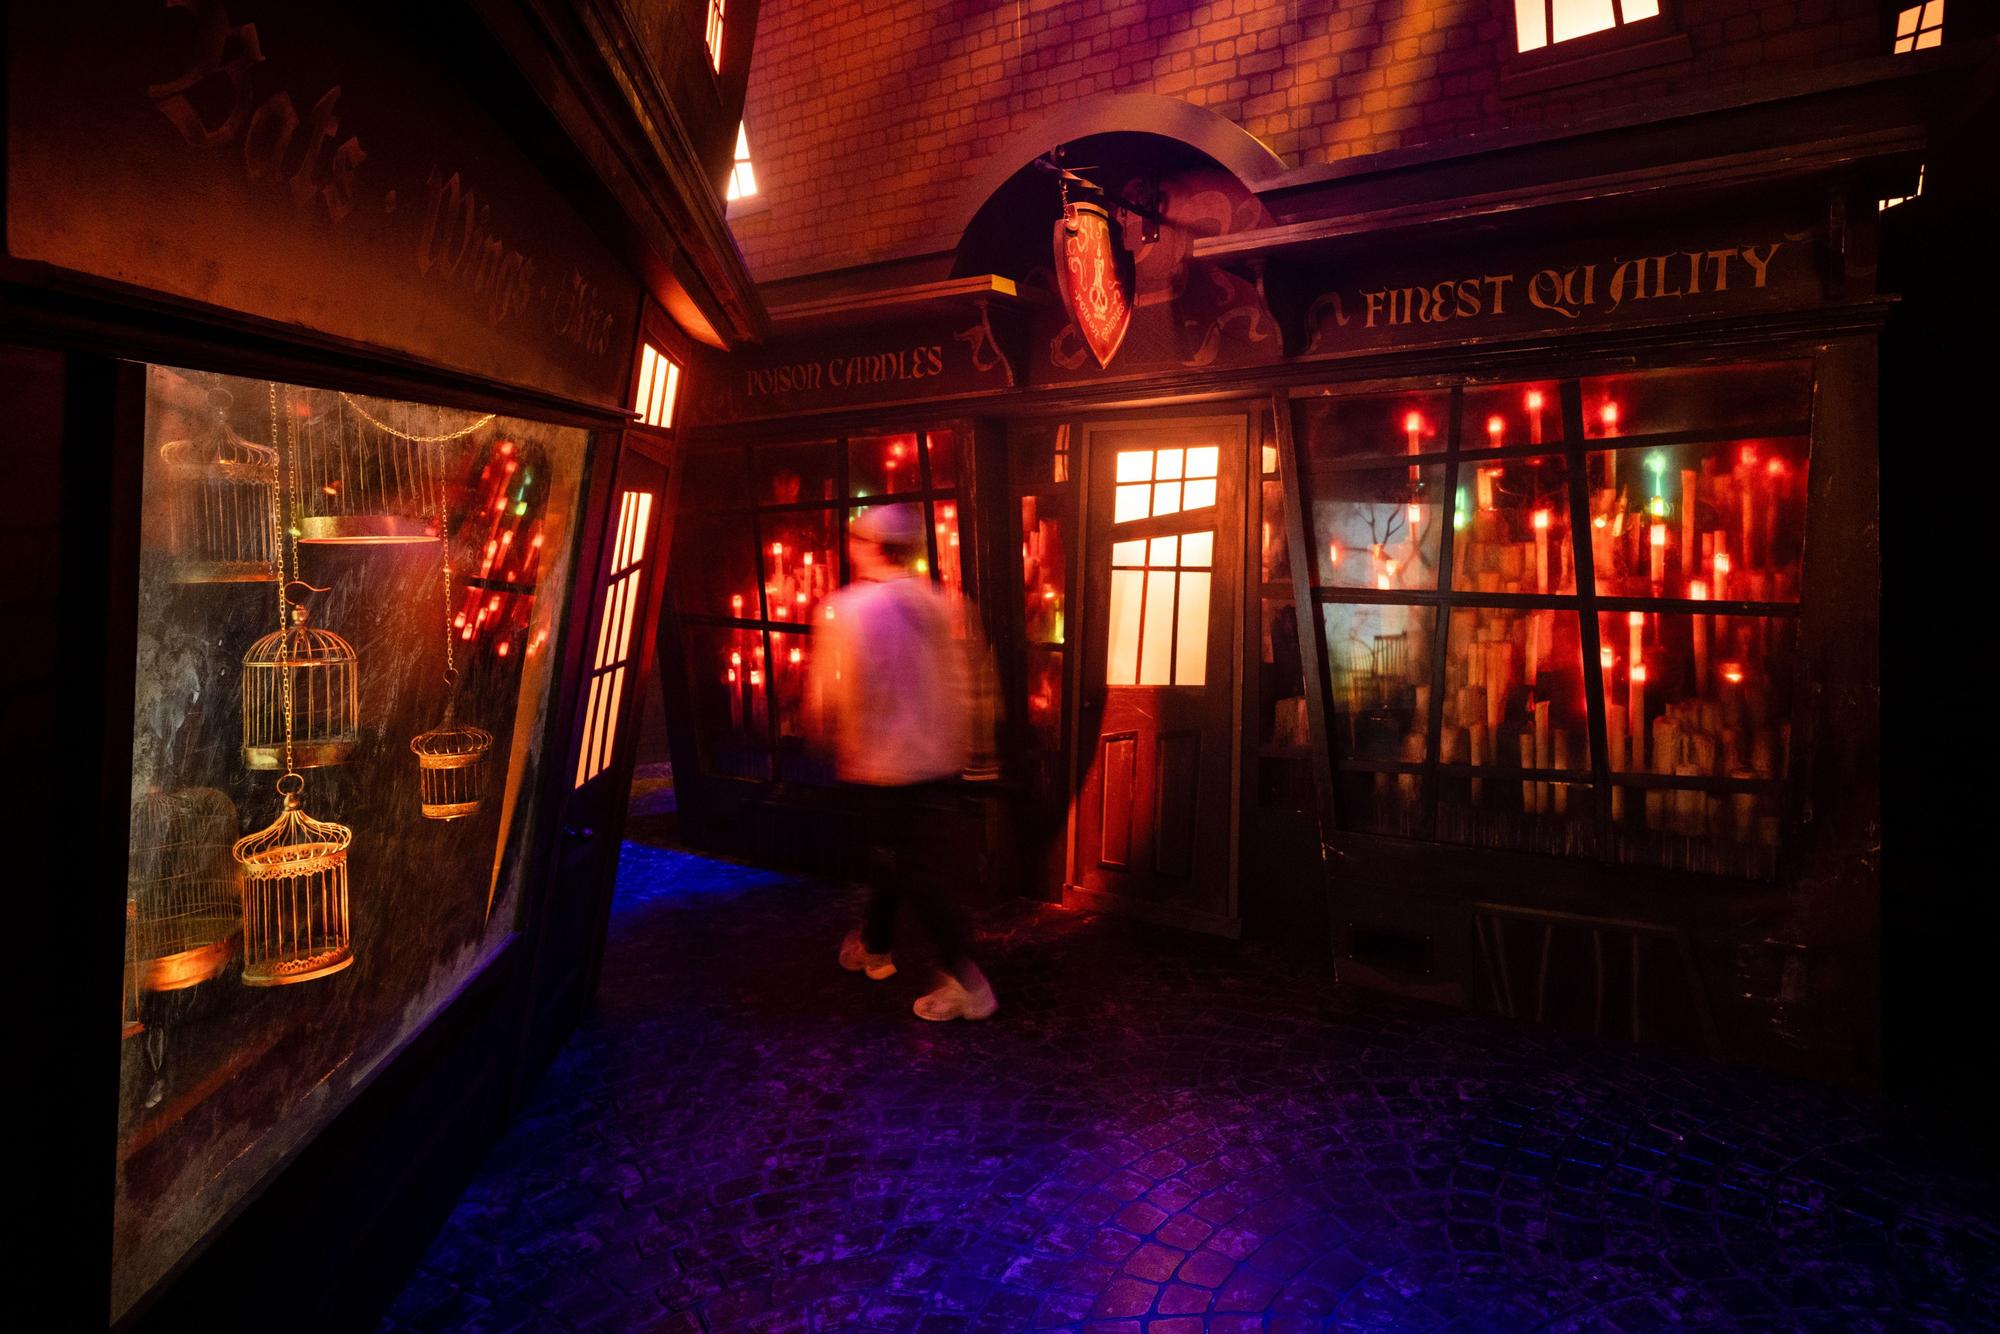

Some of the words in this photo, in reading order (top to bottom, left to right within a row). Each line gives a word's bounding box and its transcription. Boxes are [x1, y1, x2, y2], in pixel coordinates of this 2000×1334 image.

[148, 0, 367, 224] Bats
[1360, 274, 1514, 328] FINEST
[1529, 243, 1782, 318] QUALITY
[747, 361, 822, 396] POISON
[828, 346, 944, 389] CANDLES
